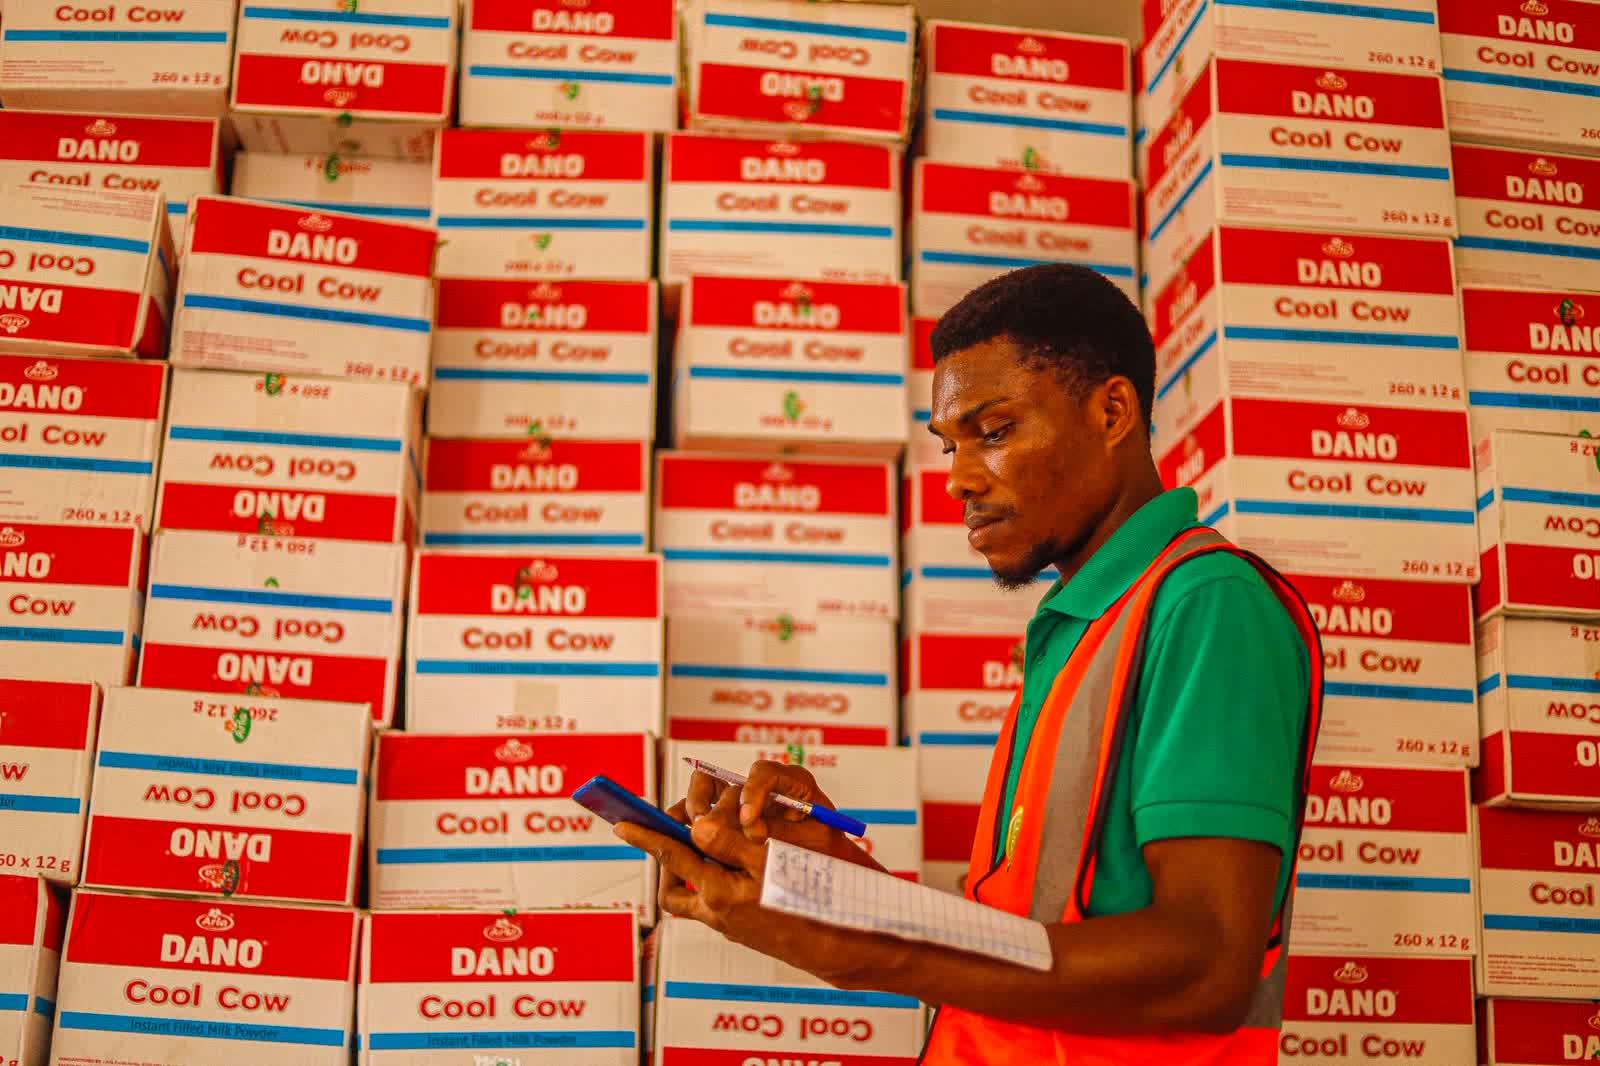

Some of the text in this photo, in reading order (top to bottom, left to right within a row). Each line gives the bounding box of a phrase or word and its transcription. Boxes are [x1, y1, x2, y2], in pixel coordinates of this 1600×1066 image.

[55, 6, 184, 22] Cool Cow
[533, 10, 613, 33] DANO
[280, 30, 411, 53] Cool Cow
[1498, 15, 1573, 43] DANO
[507, 42, 636, 63] Cool Cow
[1369, 52, 1393, 64] 260
[1410, 56, 1424, 66] 12
[1477, 47, 1600, 76] Cool Cow
[302, 61, 384, 87] DANO
[992, 54, 1068, 81] DANO
[968, 85, 1091, 112] Cool Cow
[1292, 91, 1374, 118] DANO
[58, 138, 138, 161] DANO
[1270, 127, 1402, 153] Cool Cow
[501, 154, 584, 177] DANO
[742, 158, 824, 182] DANO
[103, 173, 160, 191] Cow
[1506, 176, 1583, 204] DANO
[475, 189, 607, 208] Cool Cow
[717, 193, 848, 213] Cool Cow
[990, 192, 1067, 220] DANO
[1485, 210, 1543, 231] Cool
[268, 230, 357, 264] DANO
[28, 253, 95, 276] Cool
[1298, 259, 1381, 287] DANO
[237, 268, 381, 302] Cool Cow
[0, 284, 63, 313] DAN
[1274, 297, 1410, 322] Cool Cow
[501, 303, 587, 329] DANO
[472, 338, 538, 360] Cool
[1507, 361, 1568, 384] Cool
[0, 383, 83, 411] DANO
[0, 423, 106, 446] ol Cow
[1312, 430, 1397, 459] DANO
[210, 454, 356, 481] Cool Cow
[492, 465, 577, 490] DANO
[1288, 470, 1425, 496] Cool Cow
[234, 491, 325, 521] DANO
[463, 502, 602, 523] Cool Cow
[1545, 515, 1600, 538] Cow
[0, 551, 51, 578] NO
[1403, 561, 1428, 573] 260
[1447, 563, 1462, 575] 12
[9, 594, 74, 616] Cow
[490, 585, 586, 613] DANO
[193, 613, 344, 643] Cool Cow
[462, 628, 614, 651] Cool Cow
[218, 653, 312, 685] DANO
[1324, 648, 1421, 673] ol Cow
[1398, 740, 1423, 752] 260
[1442, 742, 1457, 753] 12
[466, 765, 562, 794] DANO
[145, 785, 306, 817] Cool Cow
[1304, 795, 1391, 825] DANO
[436, 812, 593, 834] Cool Cow
[170, 828, 272, 862] DANO
[1298, 840, 1420, 864] ool Cow
[1554, 841, 1600, 868] DA
[0, 854, 70, 872] 60 x 12 g
[1530, 883, 1594, 906] Cool
[161, 934, 262, 968] DANO
[1395, 934, 1421, 946] 260
[1440, 935, 1456, 947] 12
[1461, 938, 1469, 950] g
[452, 947, 553, 975] DANO
[126, 981, 289, 1012] Cool Cow
[420, 994, 585, 1019] Cool Cow
[1307, 989, 1395, 1016] DANO
[130, 1019, 279, 1040] Instant Filled Milk Powder
[713, 1013, 873, 1042] Cool Cow
[1281, 1033, 1424, 1057] Cool Cow
